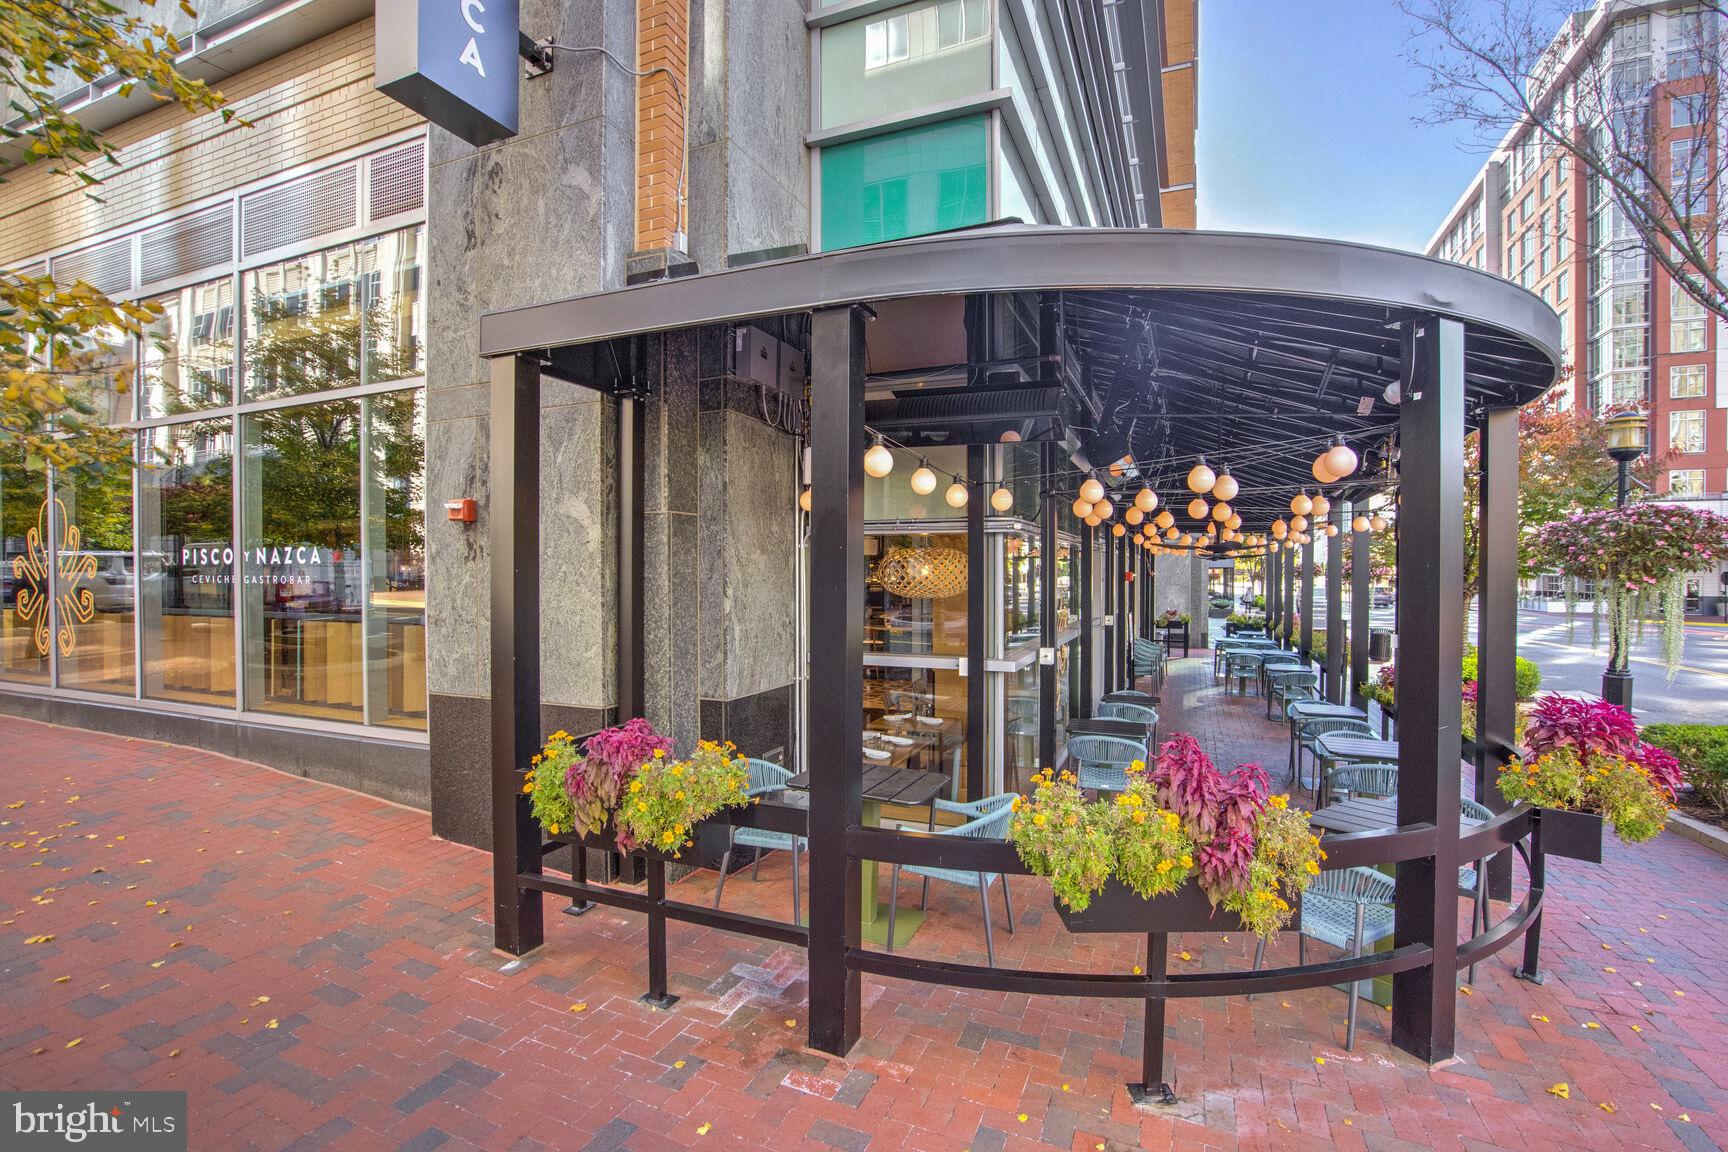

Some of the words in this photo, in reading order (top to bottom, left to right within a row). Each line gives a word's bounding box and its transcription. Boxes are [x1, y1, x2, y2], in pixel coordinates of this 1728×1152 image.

[182, 547, 234, 565] PISCO
[256, 546, 321, 565] NAZCA
[191, 574, 236, 584] CEVICHE
[243, 575, 311, 585] GASTROBAR
